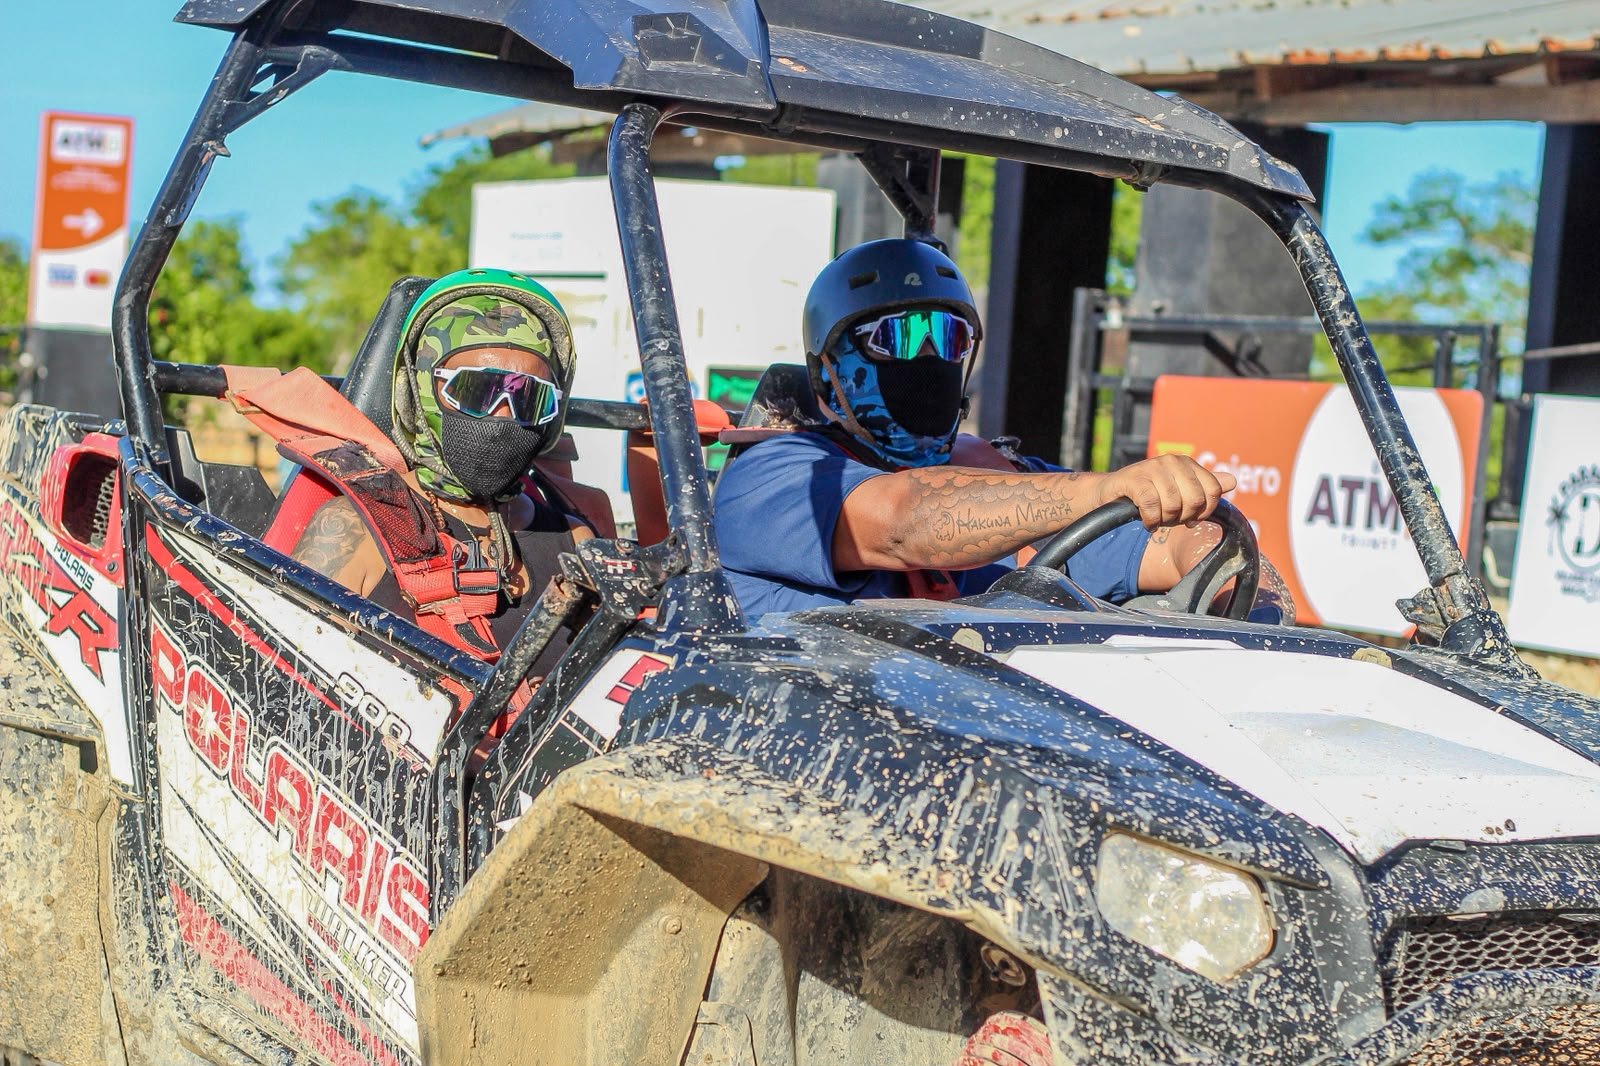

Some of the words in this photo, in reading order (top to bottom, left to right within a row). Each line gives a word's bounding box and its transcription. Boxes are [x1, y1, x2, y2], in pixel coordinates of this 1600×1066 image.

[1305, 474, 1402, 534] ATM
[53, 542, 95, 591] POLARIS
[337, 671, 412, 747] 900
[150, 616, 429, 966] POLARIS
[304, 884, 410, 1004] WALKER
